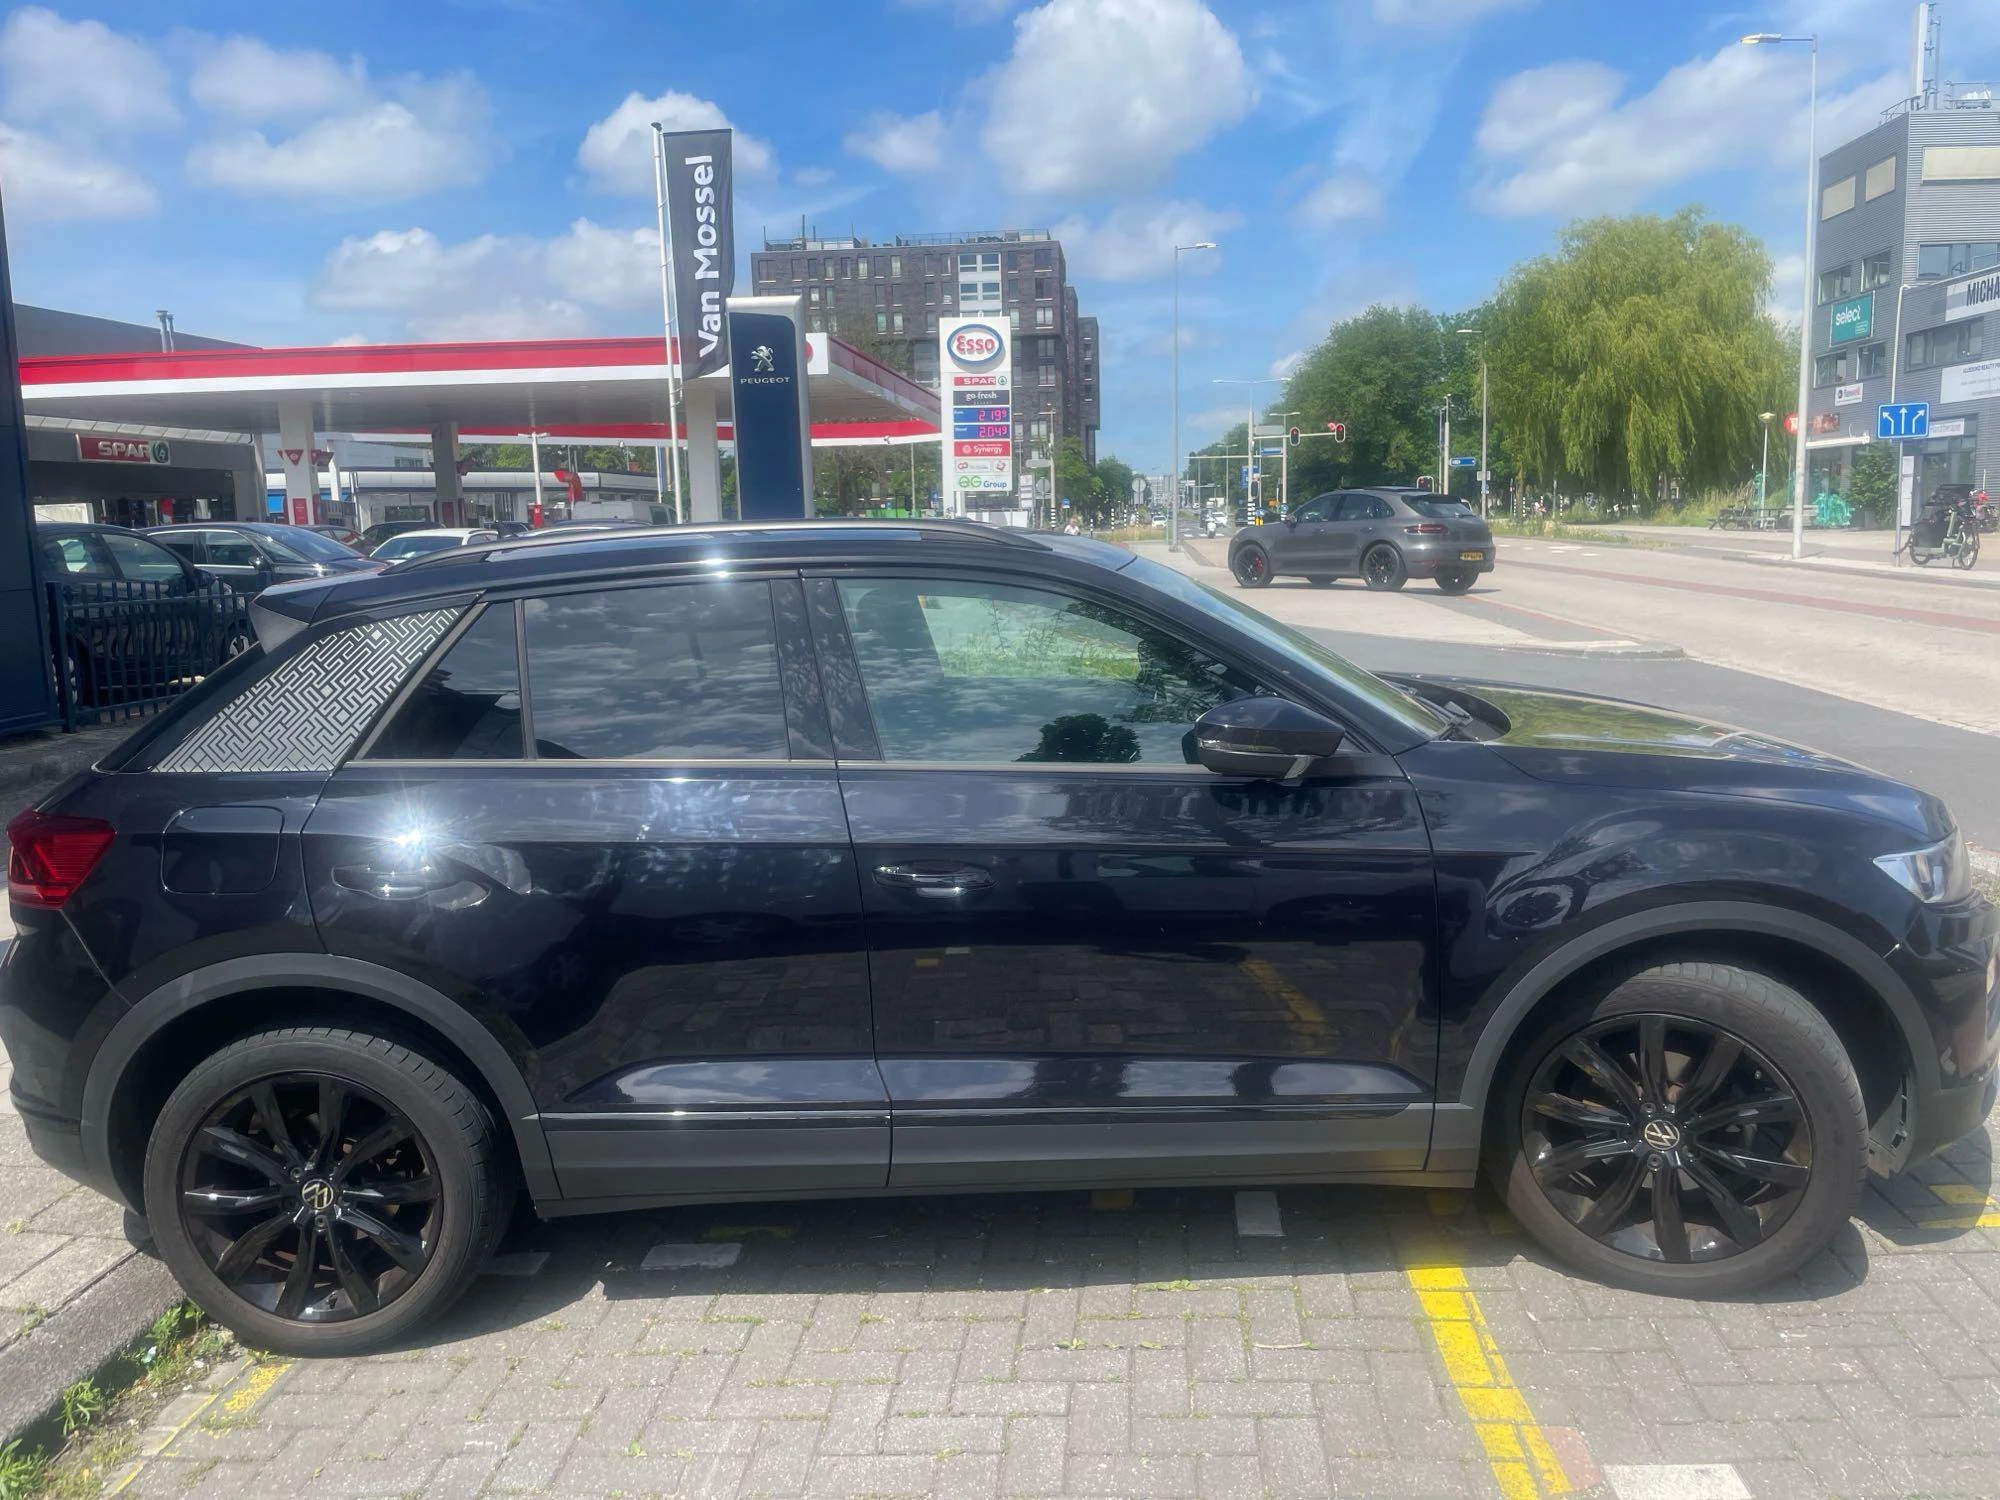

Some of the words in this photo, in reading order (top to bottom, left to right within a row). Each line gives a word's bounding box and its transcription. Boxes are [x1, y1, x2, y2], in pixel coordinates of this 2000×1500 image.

[684, 155, 720, 281] Mossel
[1966, 276, 2000, 307] MICHA
[698, 291, 722, 358] Van
[740, 376, 791, 385] PEUGEOT
[963, 377, 996, 385] SPAR
[97, 440, 151, 458] SPAR
[973, 445, 1003, 455] Synergy
[983, 480, 1008, 489] Group
